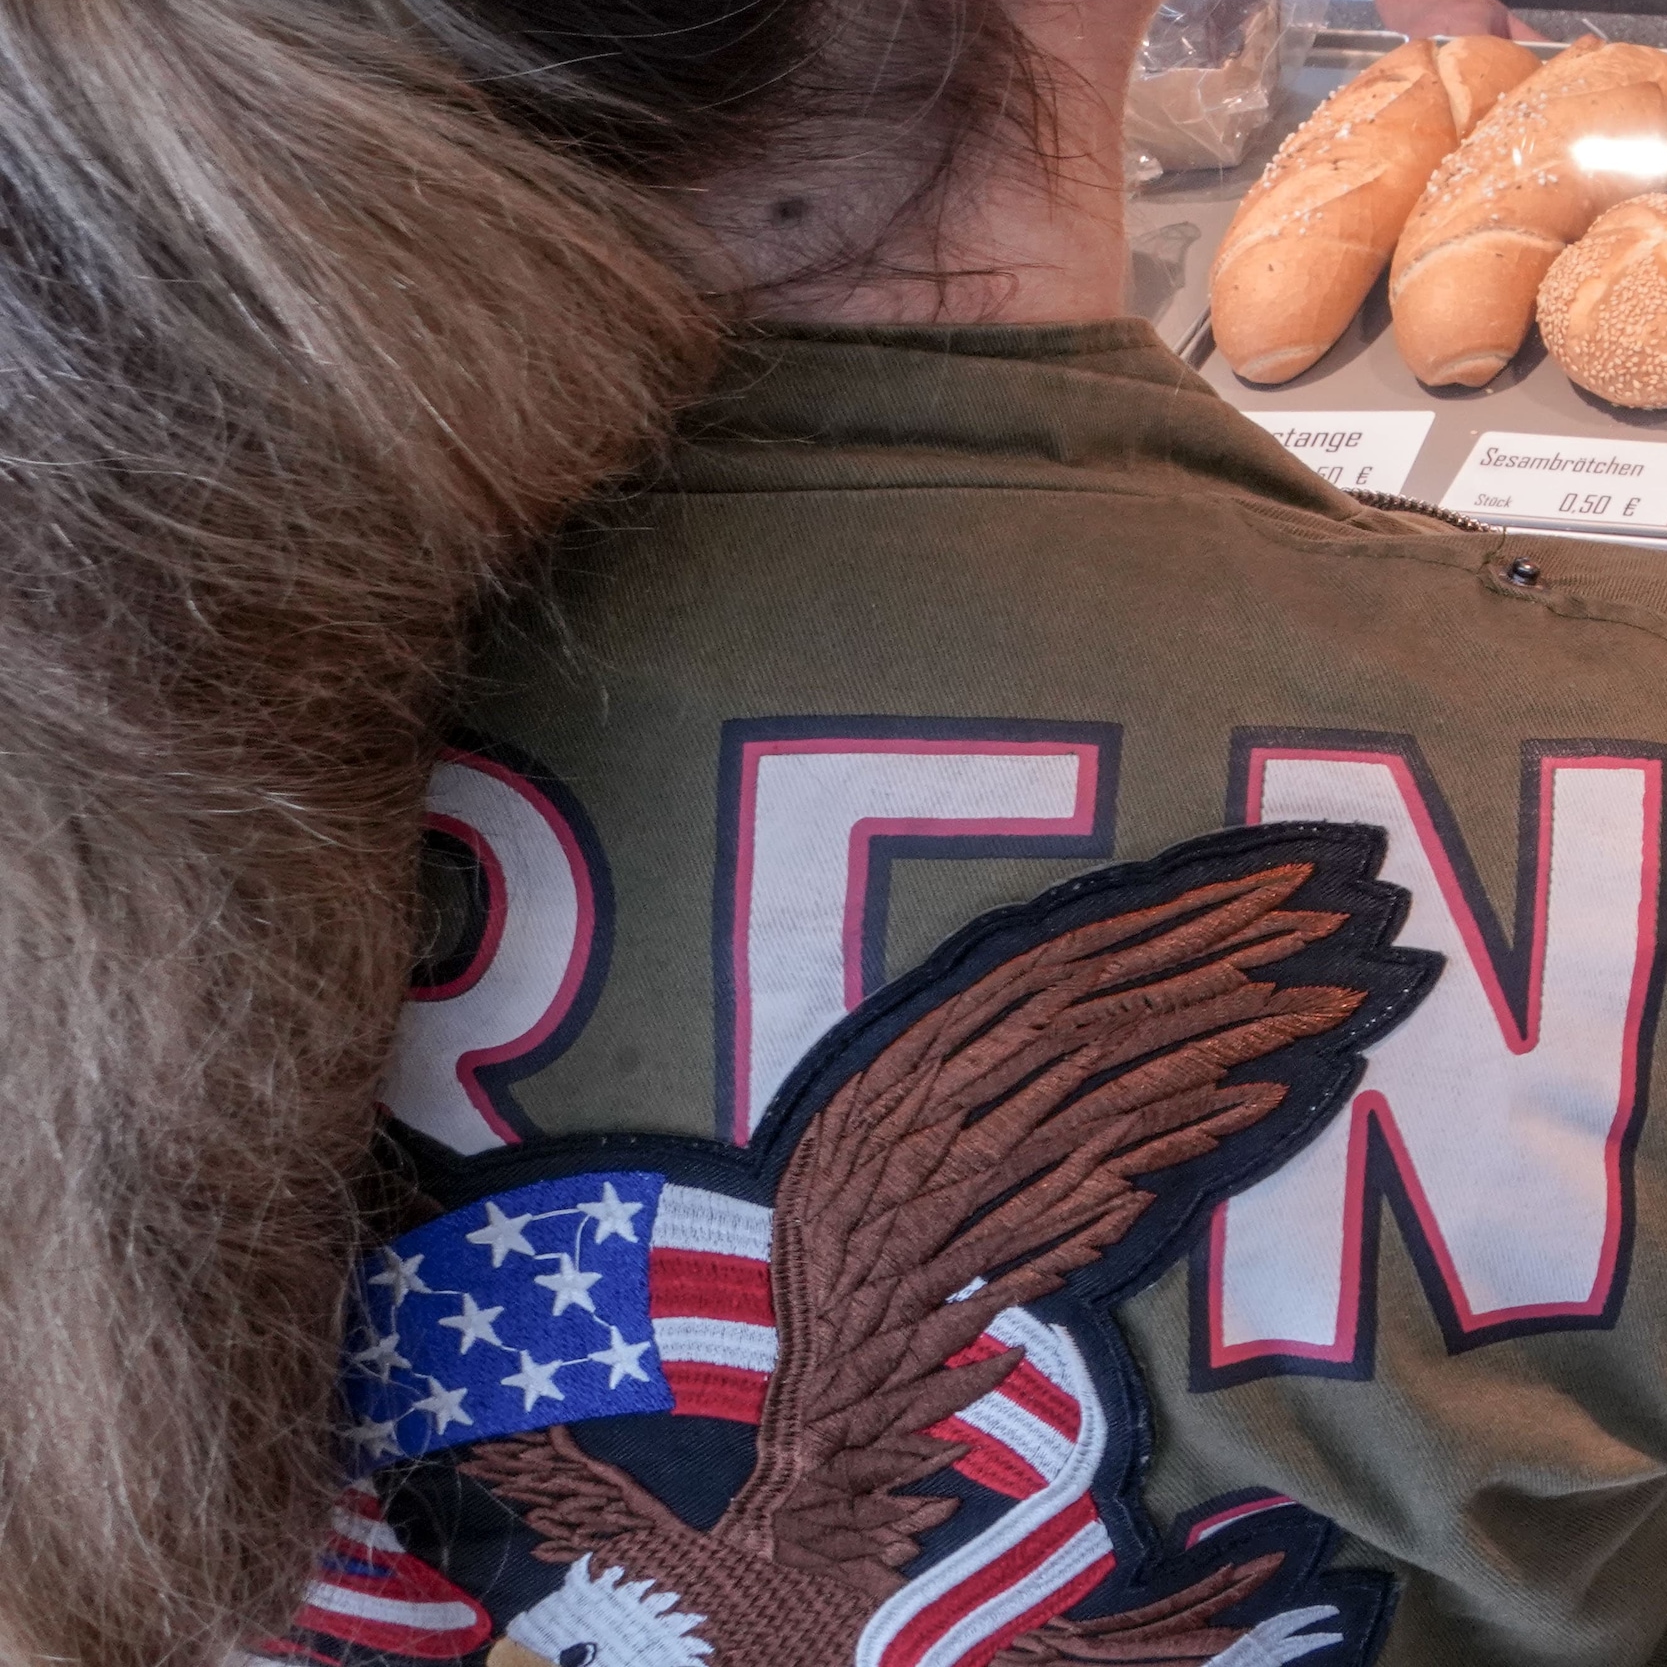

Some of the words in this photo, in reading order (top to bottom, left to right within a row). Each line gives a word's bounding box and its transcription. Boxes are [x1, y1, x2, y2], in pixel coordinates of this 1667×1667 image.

[1480, 447, 1645, 477] Sesambrötchen
[1356, 466, 1374, 485] €
[1474, 493, 1513, 509] Stück
[1623, 497, 1641, 517] €
